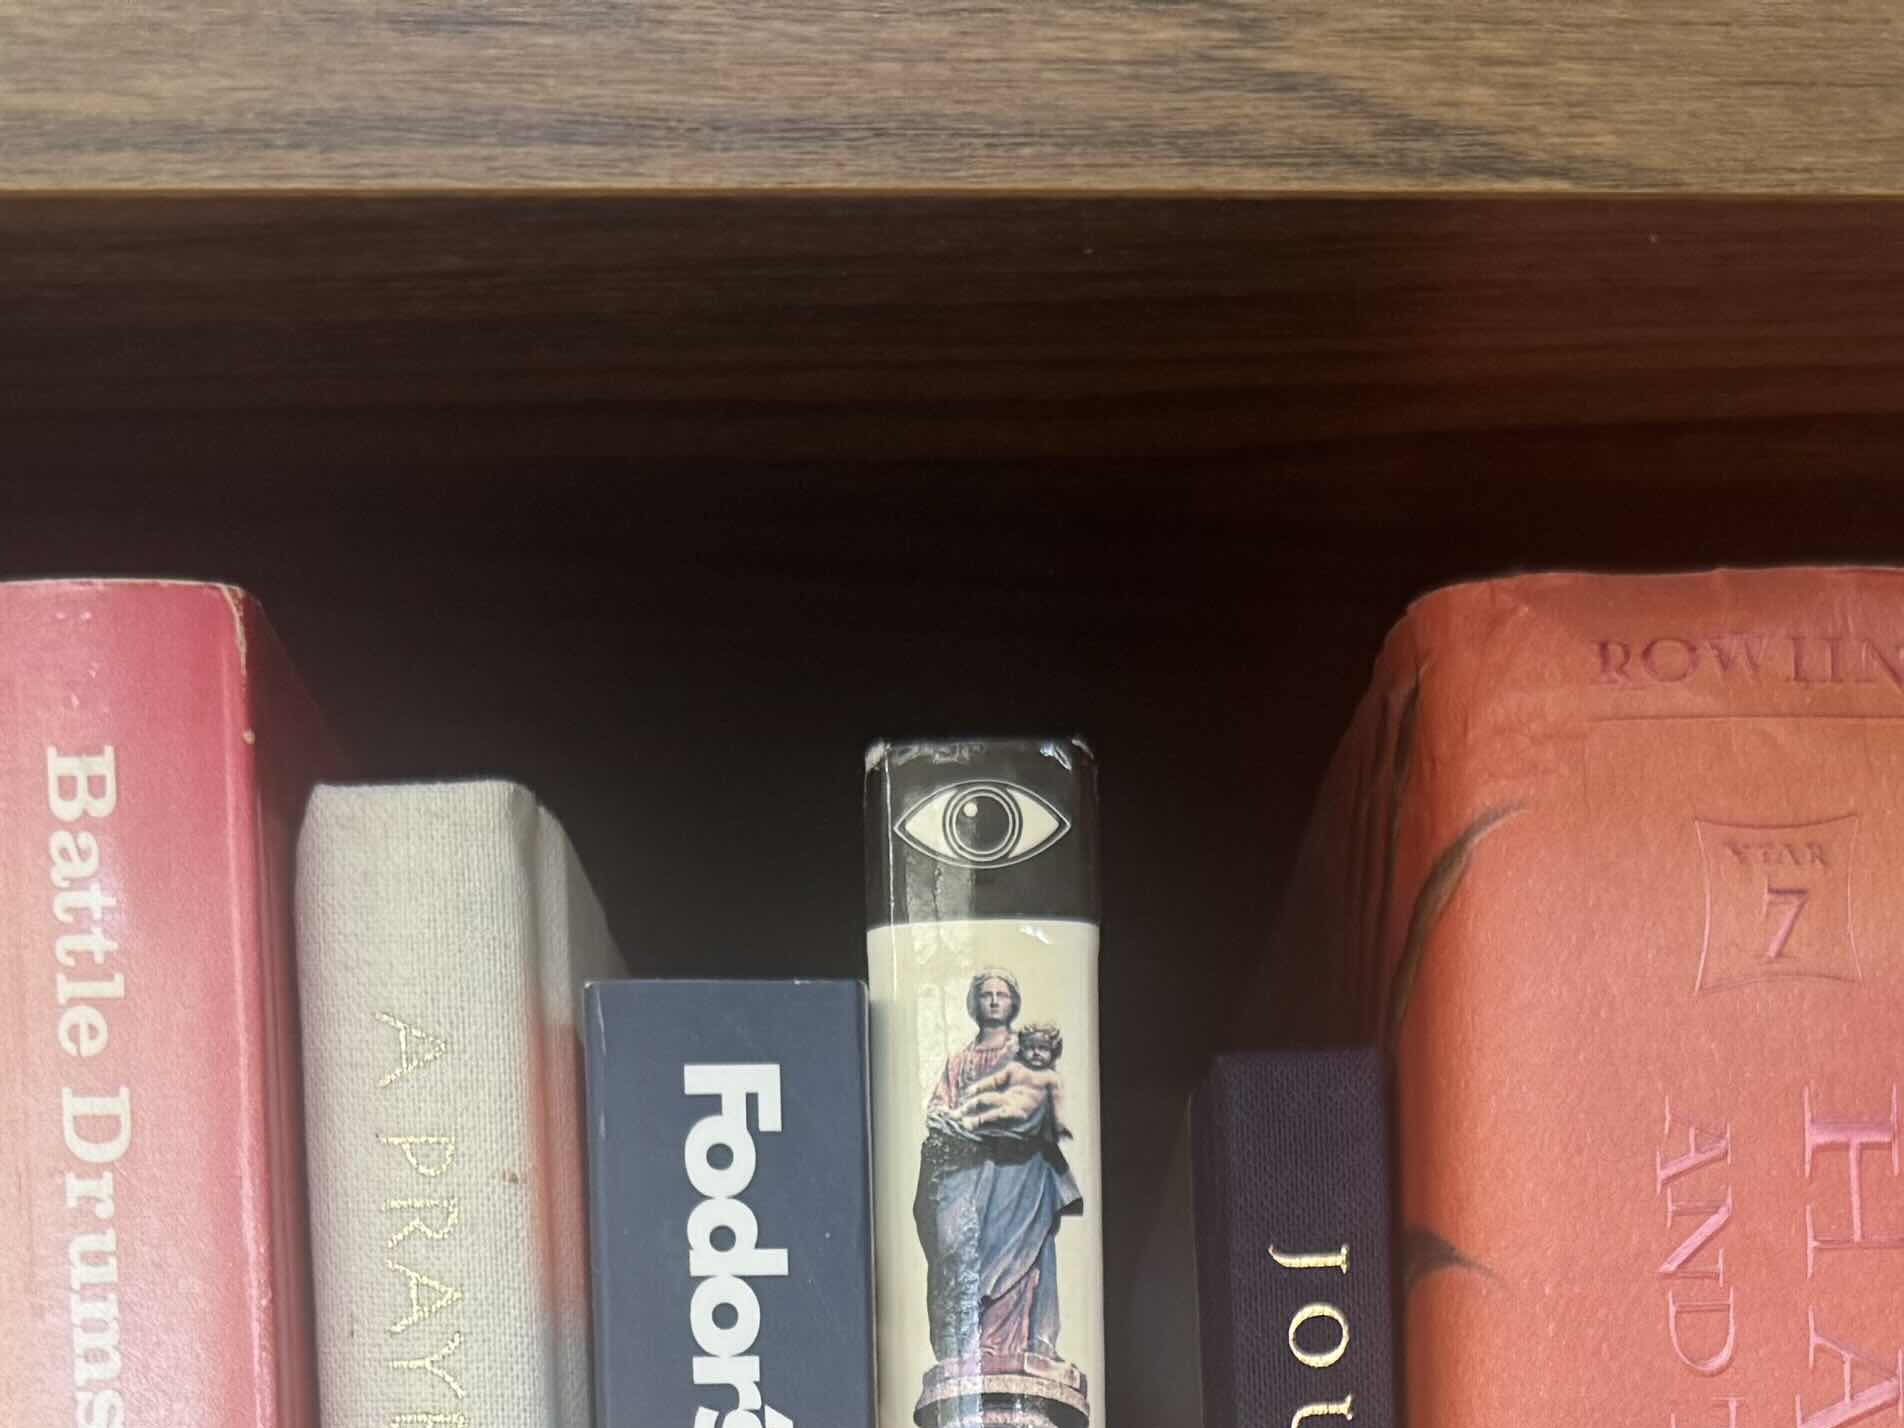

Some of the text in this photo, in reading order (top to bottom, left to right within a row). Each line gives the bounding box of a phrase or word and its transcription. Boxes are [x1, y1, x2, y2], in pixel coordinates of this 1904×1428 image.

[46, 745, 126, 1060] Battle
[1762, 886, 1809, 960] 7
[374, 1010, 448, 1090] A
[1656, 1100, 1738, 1388] AND
